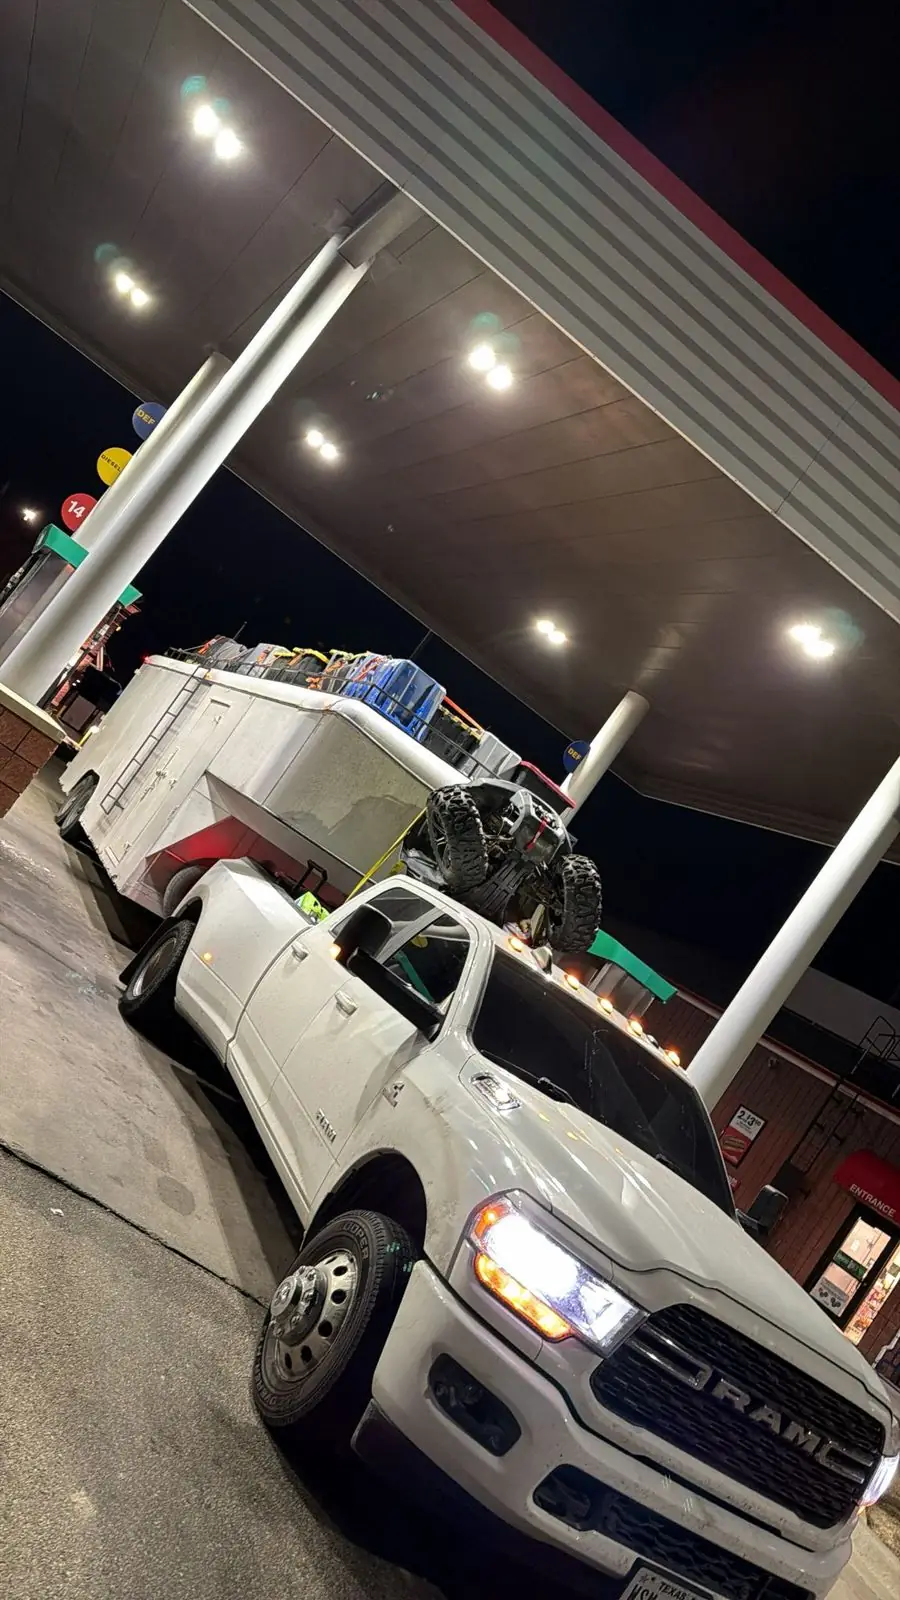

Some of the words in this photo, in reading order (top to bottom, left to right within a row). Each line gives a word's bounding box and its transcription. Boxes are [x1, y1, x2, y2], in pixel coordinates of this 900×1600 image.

[137, 409, 156, 425] DEF
[101, 454, 121, 472] DIESEL
[68, 500, 86, 518] 14
[567, 747, 582, 761] DEF
[850, 1183, 897, 1218] ENTRANCE
[711, 1378, 821, 1457] RAM
[658, 1581, 689, 1600] TEXAS
